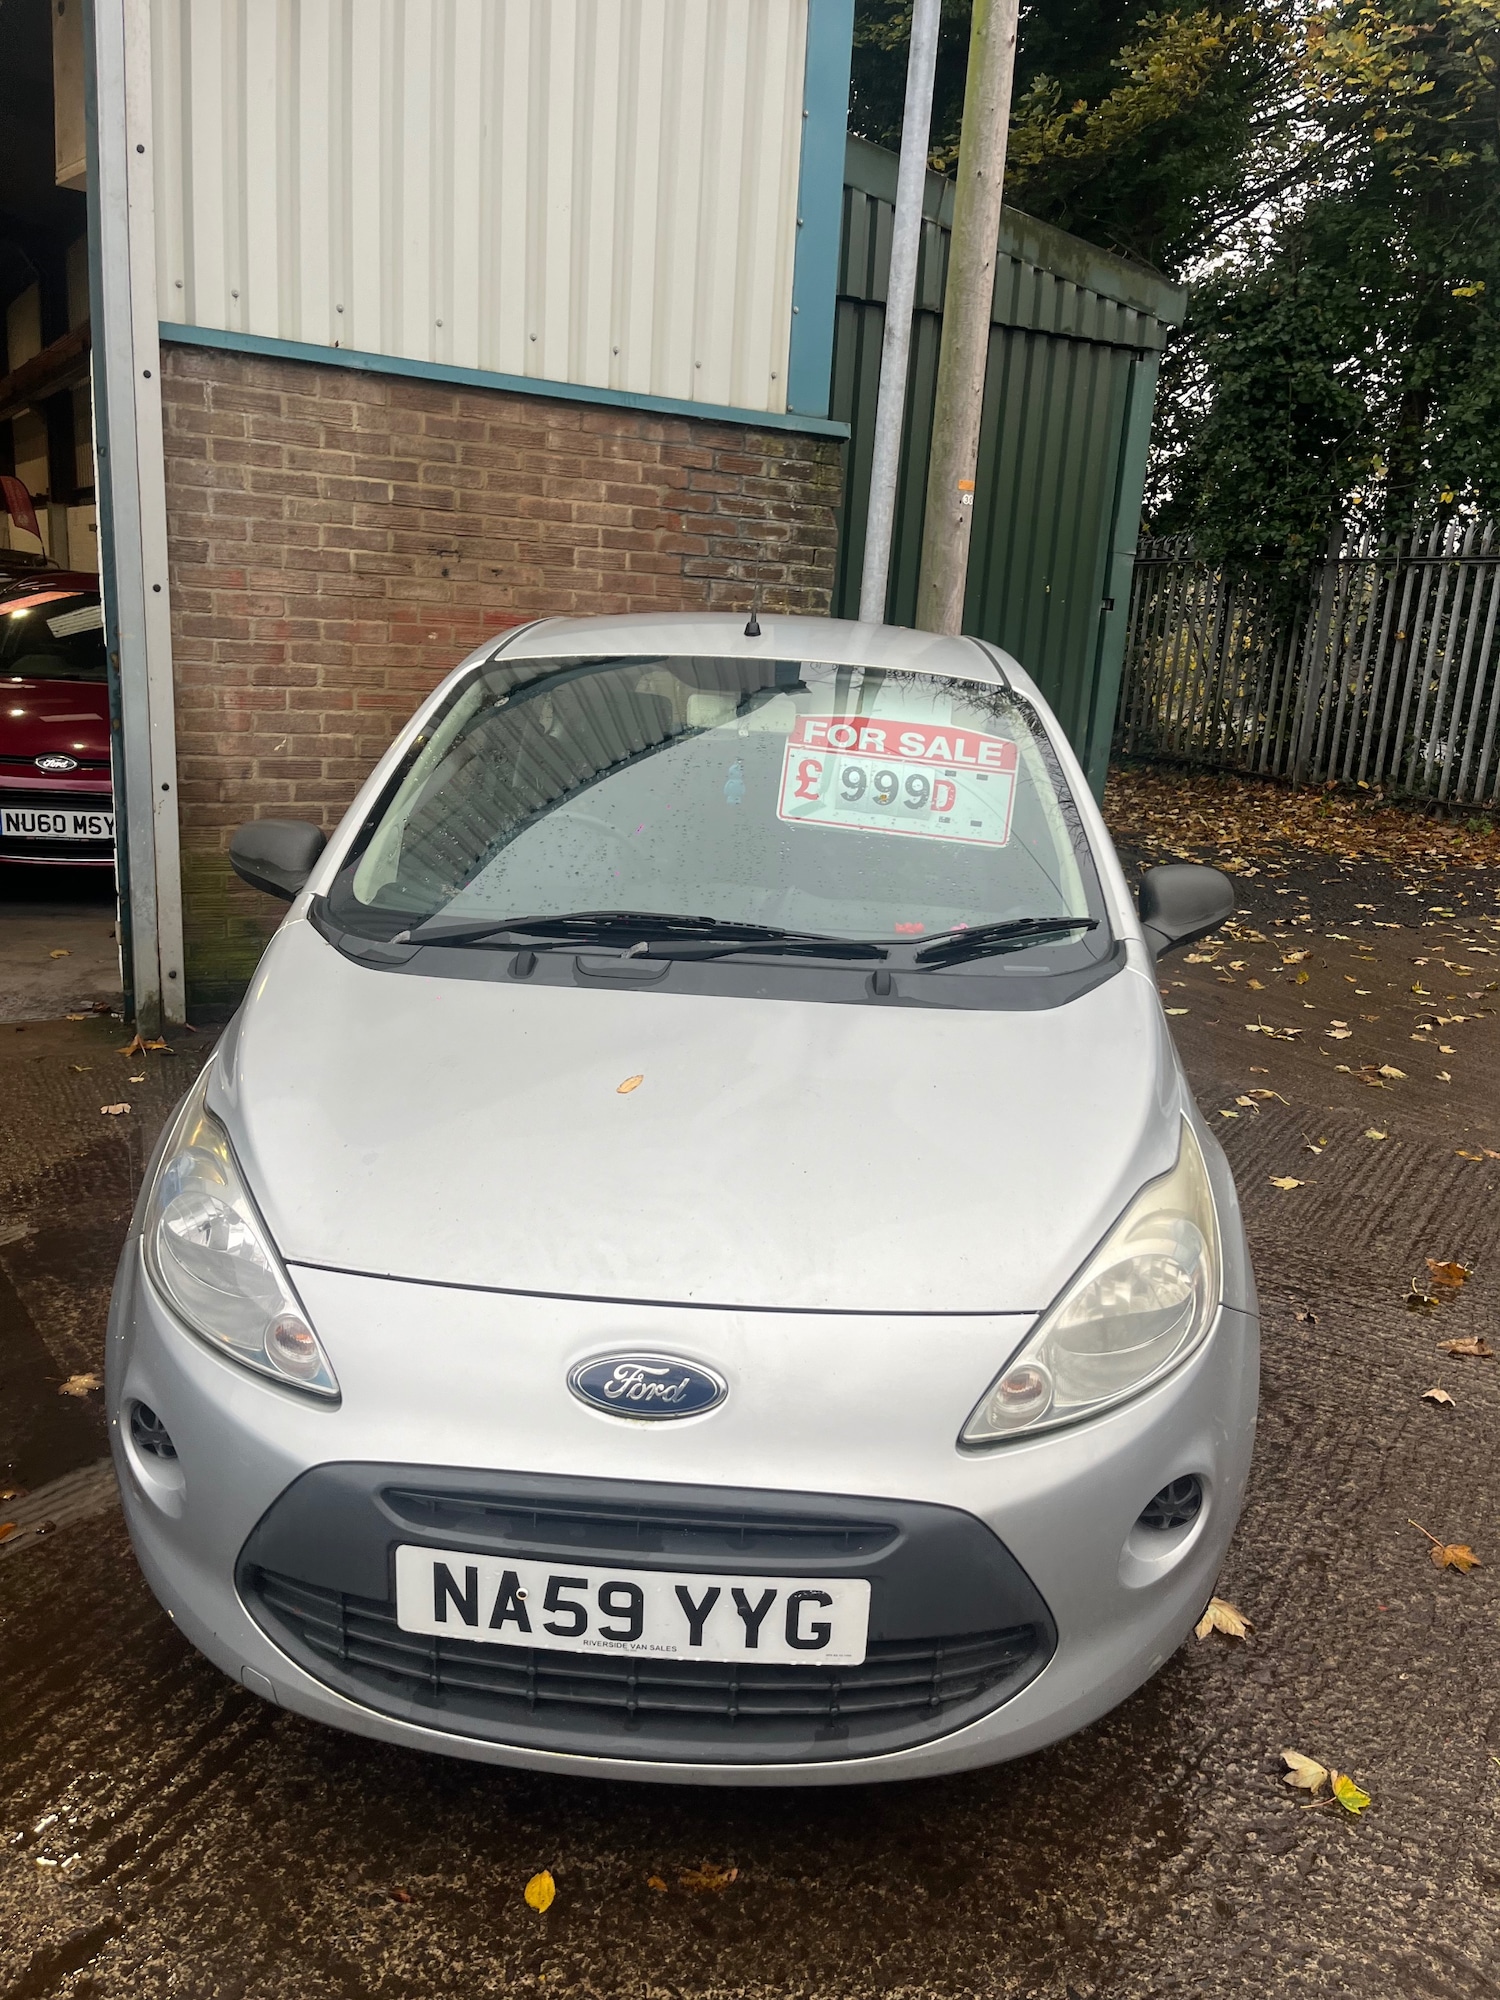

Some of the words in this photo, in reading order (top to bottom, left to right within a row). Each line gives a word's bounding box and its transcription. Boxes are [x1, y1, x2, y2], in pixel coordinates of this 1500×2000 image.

[803, 720, 887, 753] FOR
[899, 732, 1004, 767] SALE
[794, 759, 823, 800] £
[5, 813, 66, 834] NU60
[73, 815, 114, 836] MSY
[603, 1363, 691, 1404] Ford
[433, 1561, 645, 1642] NA59
[674, 1584, 834, 1650] YYG
[583, 1639, 628, 1649] RIVERSIDE
[649, 1644, 678, 1652] SALES
